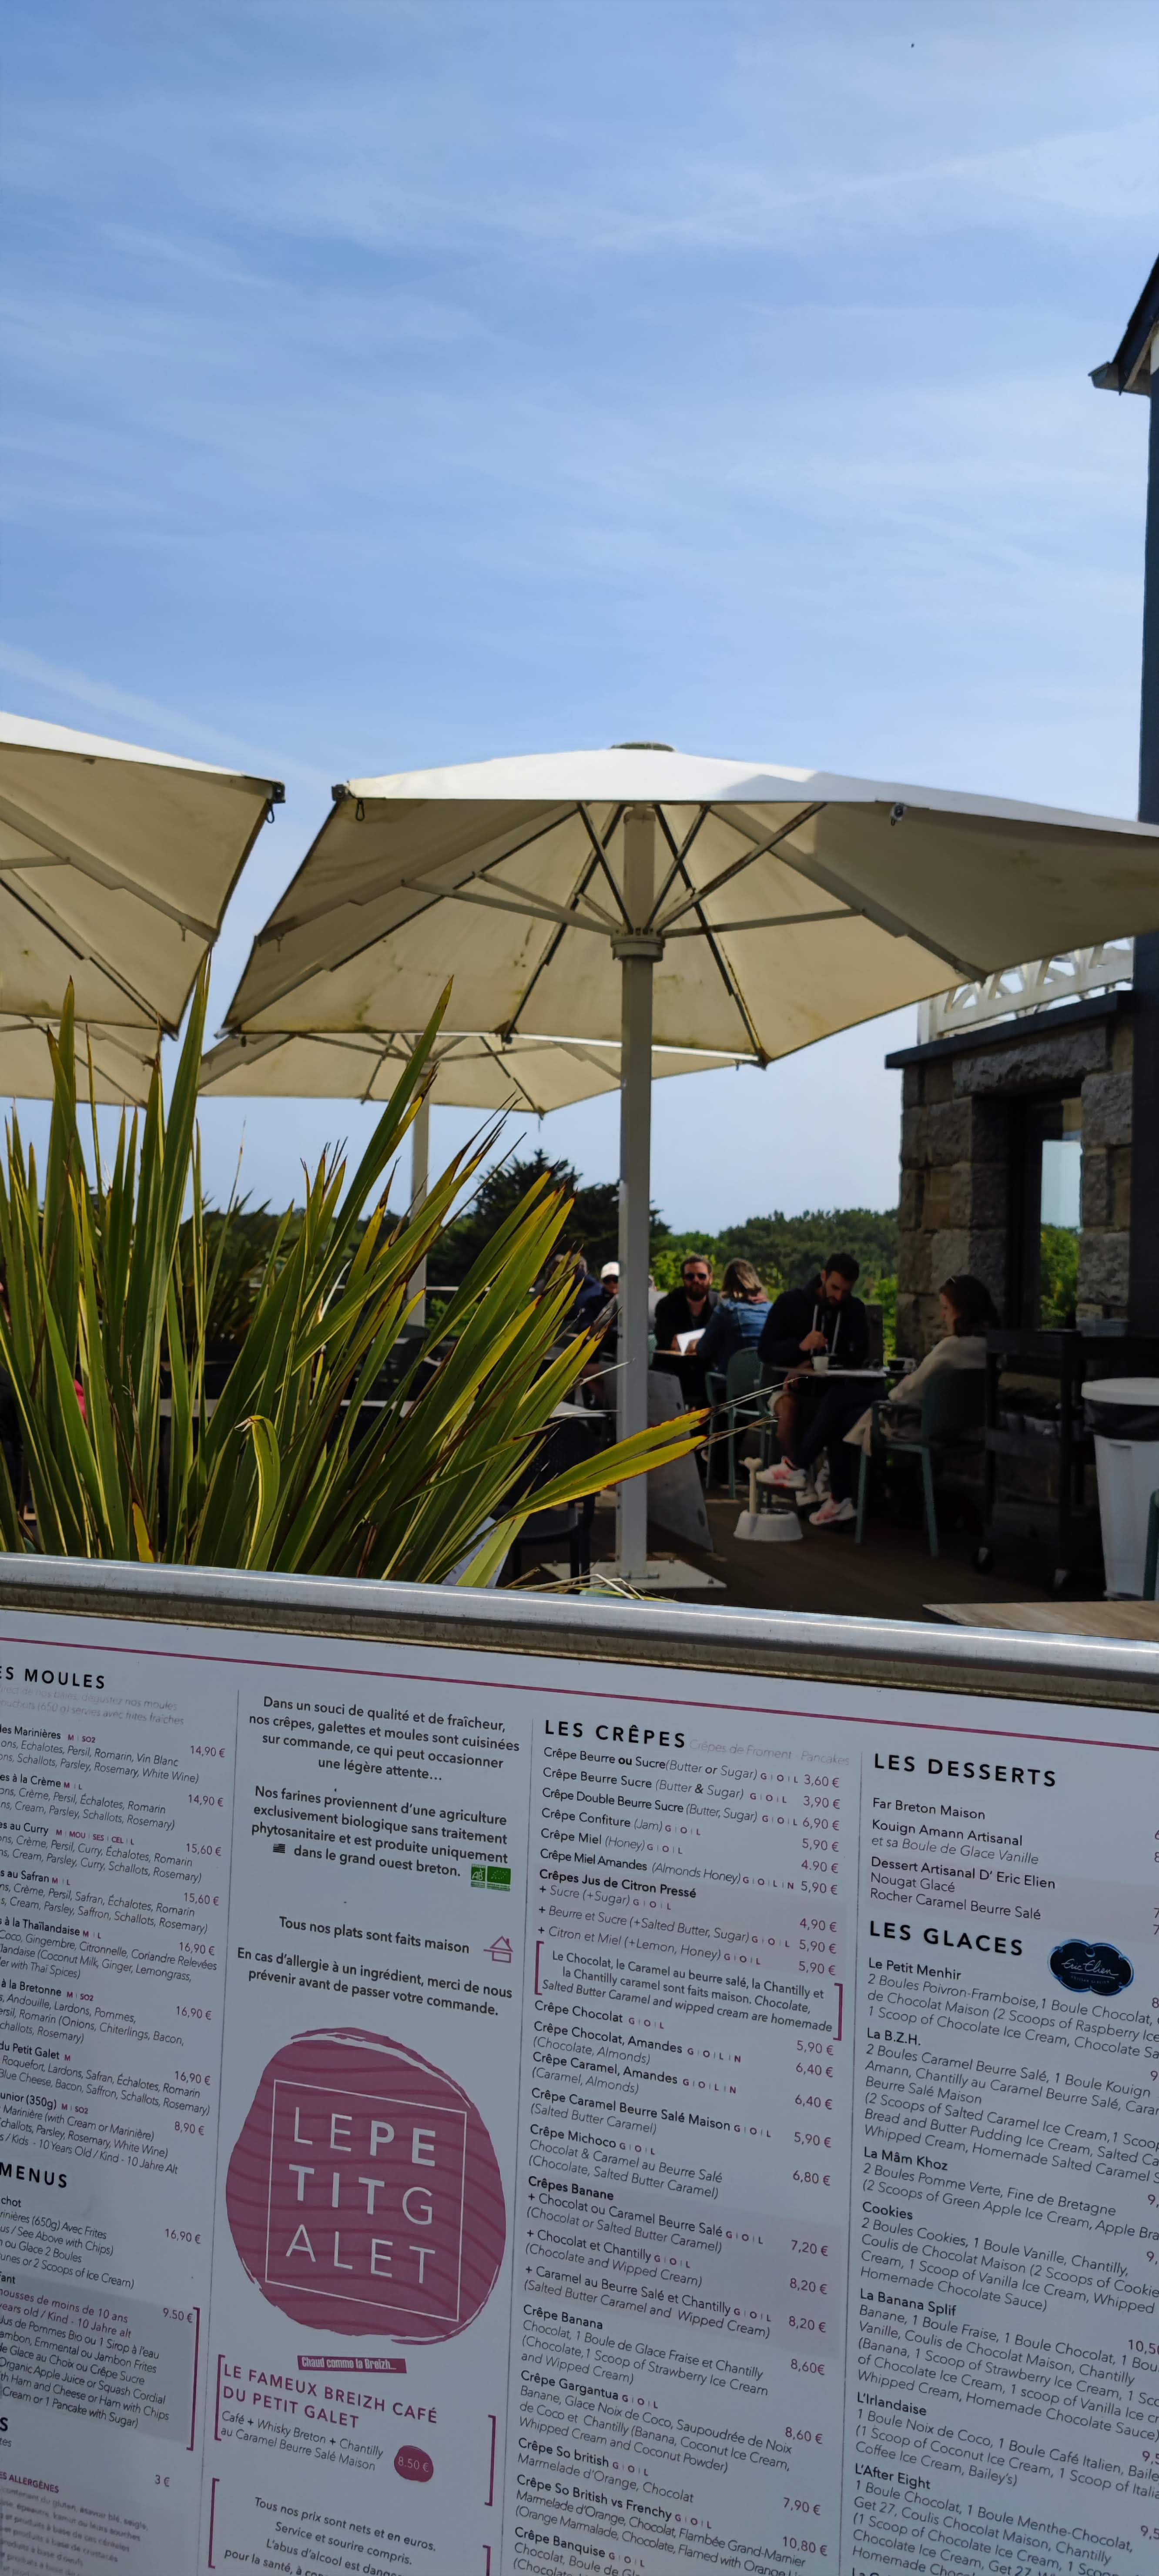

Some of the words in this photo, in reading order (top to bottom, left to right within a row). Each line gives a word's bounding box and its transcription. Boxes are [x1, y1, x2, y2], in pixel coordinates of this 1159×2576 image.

[24, 1668, 104, 1689] MOULES
[263, 1696, 293, 1710] Dans
[296, 1702, 311, 1711] un
[314, 1703, 345, 1715] souci
[348, 1704, 364, 1717] de
[367, 1707, 409, 1721] qualité
[412, 1712, 425, 1723] et
[428, 1712, 444, 1725] de
[447, 1713, 505, 1733] fraîcheur,
[14, 1725, 61, 1740] Marinières
[249, 1715, 270, 1725] nos
[273, 1716, 315, 1732] crêpes,
[318, 1720, 366, 1735] galettes
[368, 1727, 382, 1737] et
[384, 1728, 429, 1742] moules
[432, 1734, 459, 1745] sont
[462, 1735, 519, 1751] cuisinées
[545, 1719, 583, 1738] LES
[595, 1724, 685, 1748] CRÊPES
[190, 1745, 216, 1757] 14,90
[218, 1748, 225, 1758] €
[262, 1734, 281, 1744] sur
[283, 1737, 353, 1754] commande,
[356, 1745, 370, 1754] ce
[373, 1745, 393, 1759] qui
[396, 1749, 425, 1761] peut
[428, 1752, 504, 1768] occasionner
[17, 1753, 57, 1768] Schallots,
[60, 1758, 91, 1773] Parsley,
[94, 1761, 139, 1778] Rosemary,
[143, 1767, 169, 1780] White
[172, 1771, 199, 1784] Wine)
[874, 1753, 915, 1772] LES
[928, 1758, 1056, 1787] DESSERTS
[543, 1767, 577, 1782] Crêpe
[580, 1771, 617, 1784] Beurre
[620, 1775, 652, 1788] Sucre
[655, 1778, 693, 1792] (Butter
[694, 1783, 704, 1794] &
[707, 1784, 744, 1800] Sugar)
[803, 1795, 829, 1808] 3,90
[832, 1798, 841, 1810] €
[873, 1797, 892, 1809] Far
[895, 1799, 936, 1814] Breton
[940, 1804, 985, 1820] Maison
[872, 1818, 915, 1836] Kouign
[918, 1824, 964, 1840] Amann
[967, 1829, 1022, 1846] Artisanal
[186, 1842, 212, 1855] 15,60
[214, 1846, 221, 1857] €
[539, 1868, 579, 1884] Crêpes
[581, 1874, 600, 1886] Jus
[603, 1876, 619, 1888] de
[621, 1879, 656, 1893] Citron
[660, 1883, 697, 1898] Pressé
[871, 1872, 917, 1889] Nougat
[920, 1878, 955, 1893] Glacé
[870, 1887, 913, 1903] Rocher
[915, 1893, 966, 1910] Caramel
[971, 1900, 1011, 1916] Beurre
[1015, 1905, 1041, 1920] Salé
[278, 1915, 306, 1931] Tous
[309, 1923, 331, 1934] nos
[334, 1923, 363, 1939] plats
[365, 1931, 393, 1943] sont
[395, 1932, 421, 1947] faits
[424, 1939, 469, 1954] maison
[870, 1920, 911, 1941] LES
[923, 1928, 1022, 1956] GLACES
[553, 1950, 564, 1961] Le
[566, 1952, 613, 1970] Chocolat,
[616, 1958, 625, 1970] le
[628, 1961, 670, 1976] Caramel
[673, 1970, 685, 1979] au
[688, 1968, 723, 1984] beurre
[725, 1975, 749, 1989] salé,
[752, 1977, 760, 1989] la
[764, 1980, 811, 1999] Chantilly
[813, 1989, 824, 1999] et
[868, 1956, 883, 1969] Le
[886, 1959, 914, 1974] Petit
[917, 1963, 962, 1980] Menhir
[1062, 1959, 1082, 1970] Eric
[533, 2020, 568, 2037] Crêpe
[571, 2026, 625, 2046] Chocolat,
[627, 2035, 682, 2053] Amandes
[867, 2027, 881, 2040] La
[884, 2029, 921, 2046] B.Z.H.
[795, 2062, 822, 2076] 6,40
[825, 2066, 834, 2078] €
[0, 2162, 67, 2189] MENUS
[862, 2201, 913, 2220] Cookies
[164, 2228, 192, 2242] 16,90
[194, 2234, 201, 2244] €
[860, 2288, 874, 2301] La
[878, 2291, 924, 2311] Banana
[927, 2301, 957, 2317] Splif
[523, 2304, 558, 2321] Crêpe
[561, 2311, 603, 2330] Banana
[9, 2345, 34, 2359] Glace
[36, 2353, 47, 2362] au
[49, 2354, 74, 2369] Choix
[76, 2363, 88, 2372] ou
[90, 2364, 118, 2379] Crêpe
[119, 2371, 145, 2385] Sucre
[34, 2336, 80, 2355] Emmental
[80, 2350, 93, 2358] ou
[94, 2351, 131, 2368] Jambon
[133, 2359, 157, 2373] Frites
[301, 2357, 325, 2368] Chaud
[326, 2358, 354, 2368] comme
[355, 2358, 363, 2369] la
[791, 2358, 825, 2376] 8,60€
[224, 2363, 241, 2379] LE
[248, 2368, 317, 2397] FAMEUX
[324, 2386, 385, 2412] BREIZH
[392, 2402, 437, 2424] CAFÉ
[521, 2370, 556, 2387] Crêpe
[558, 2378, 619, 2400] Gargantua
[223, 2385, 246, 2402] DU
[252, 2392, 298, 2414] PETIT
[304, 2405, 359, 2428] GALET
[785, 2426, 811, 2442] 8,60
[814, 2433, 823, 2445] €
[398, 2456, 419, 2470] 8.50
[423, 2462, 429, 2472] €
[518, 2437, 553, 2455] Crêpe
[556, 2445, 571, 2459] So
[574, 2448, 609, 2468] british
[9, 2474, 59, 2493] ALLERGÈNES
[898, 2471, 931, 2490] Eight
[255, 2496, 278, 2512] Tous
[280, 2506, 299, 2517] nos
[301, 2511, 322, 2522] prix
[323, 2516, 347, 2529] sont
[348, 2523, 371, 2535] nets
[374, 2529, 385, 2539] et
[387, 2532, 401, 2542] en
[403, 2536, 435, 2552] euros.
[515, 2526, 549, 2545] Crêpe
[553, 2535, 605, 2558] Banquise
